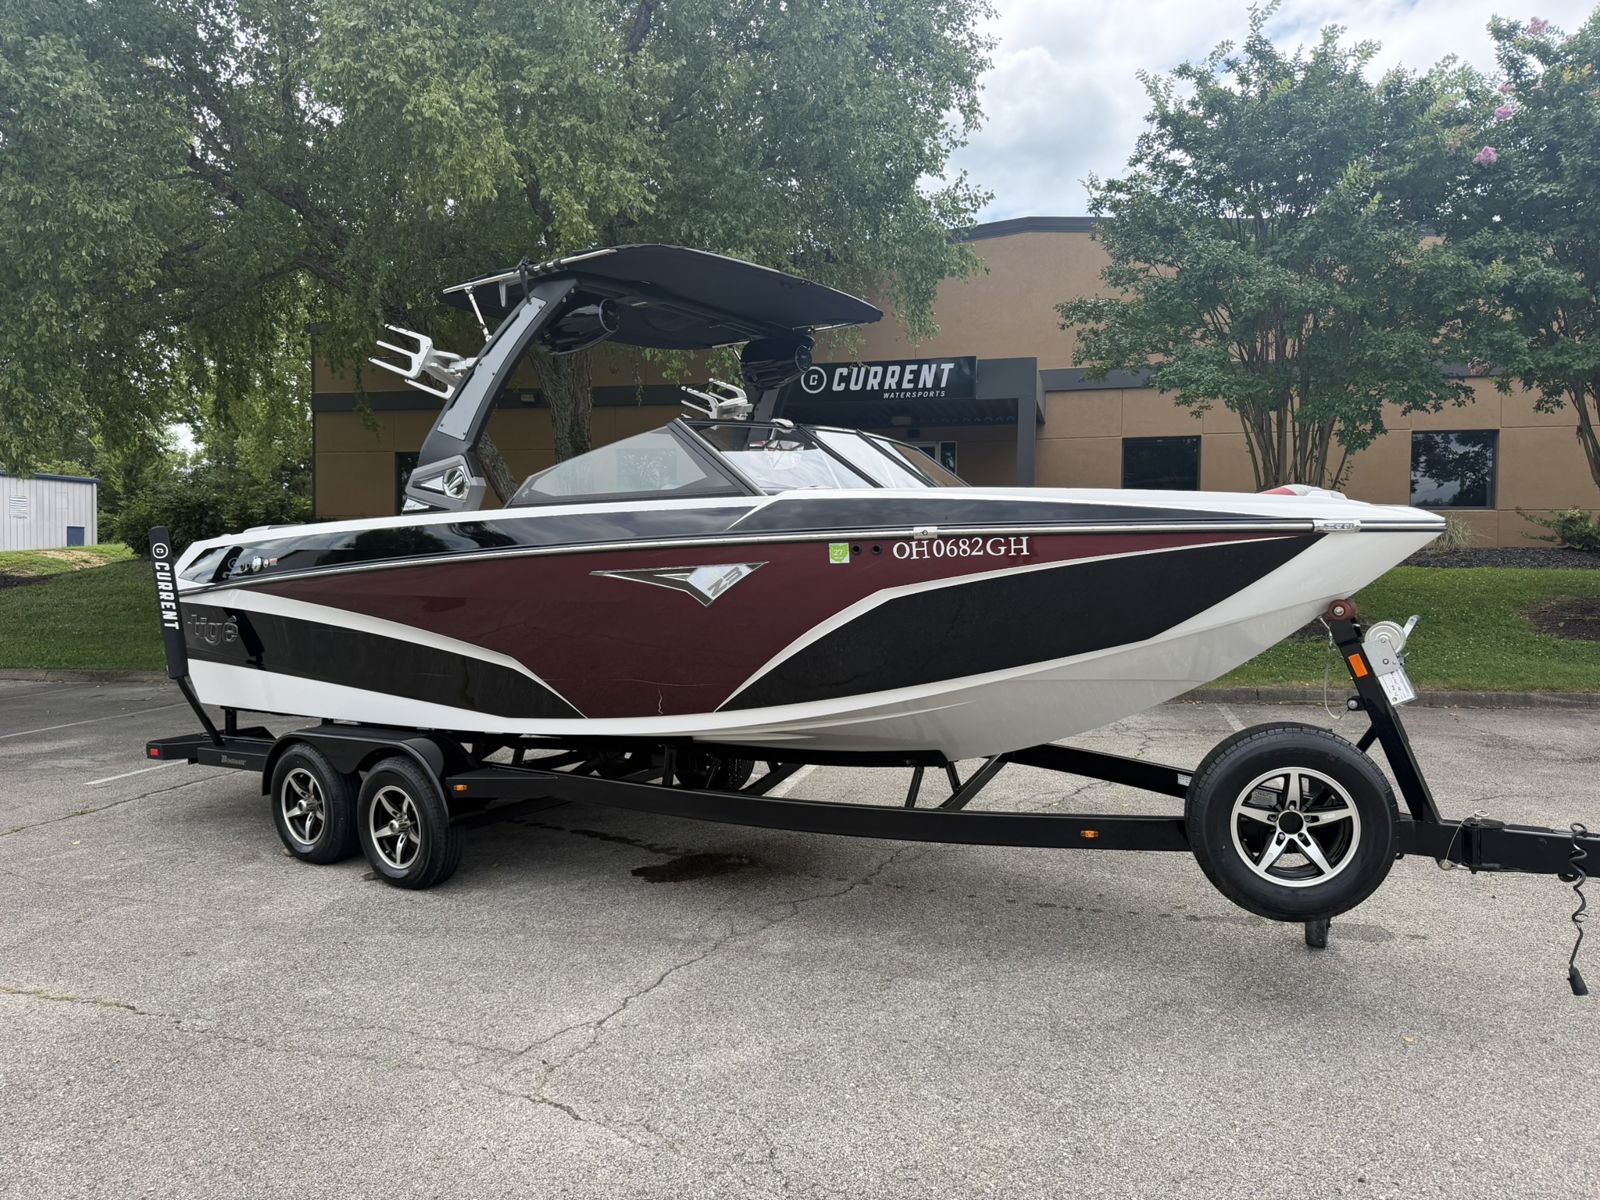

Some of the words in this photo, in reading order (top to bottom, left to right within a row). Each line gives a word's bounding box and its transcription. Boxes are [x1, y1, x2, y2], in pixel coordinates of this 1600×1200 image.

[832, 363, 955, 391] CURRENT
[883, 390, 946, 399] WATERSPORTS
[154, 561, 180, 630] CURRENT
